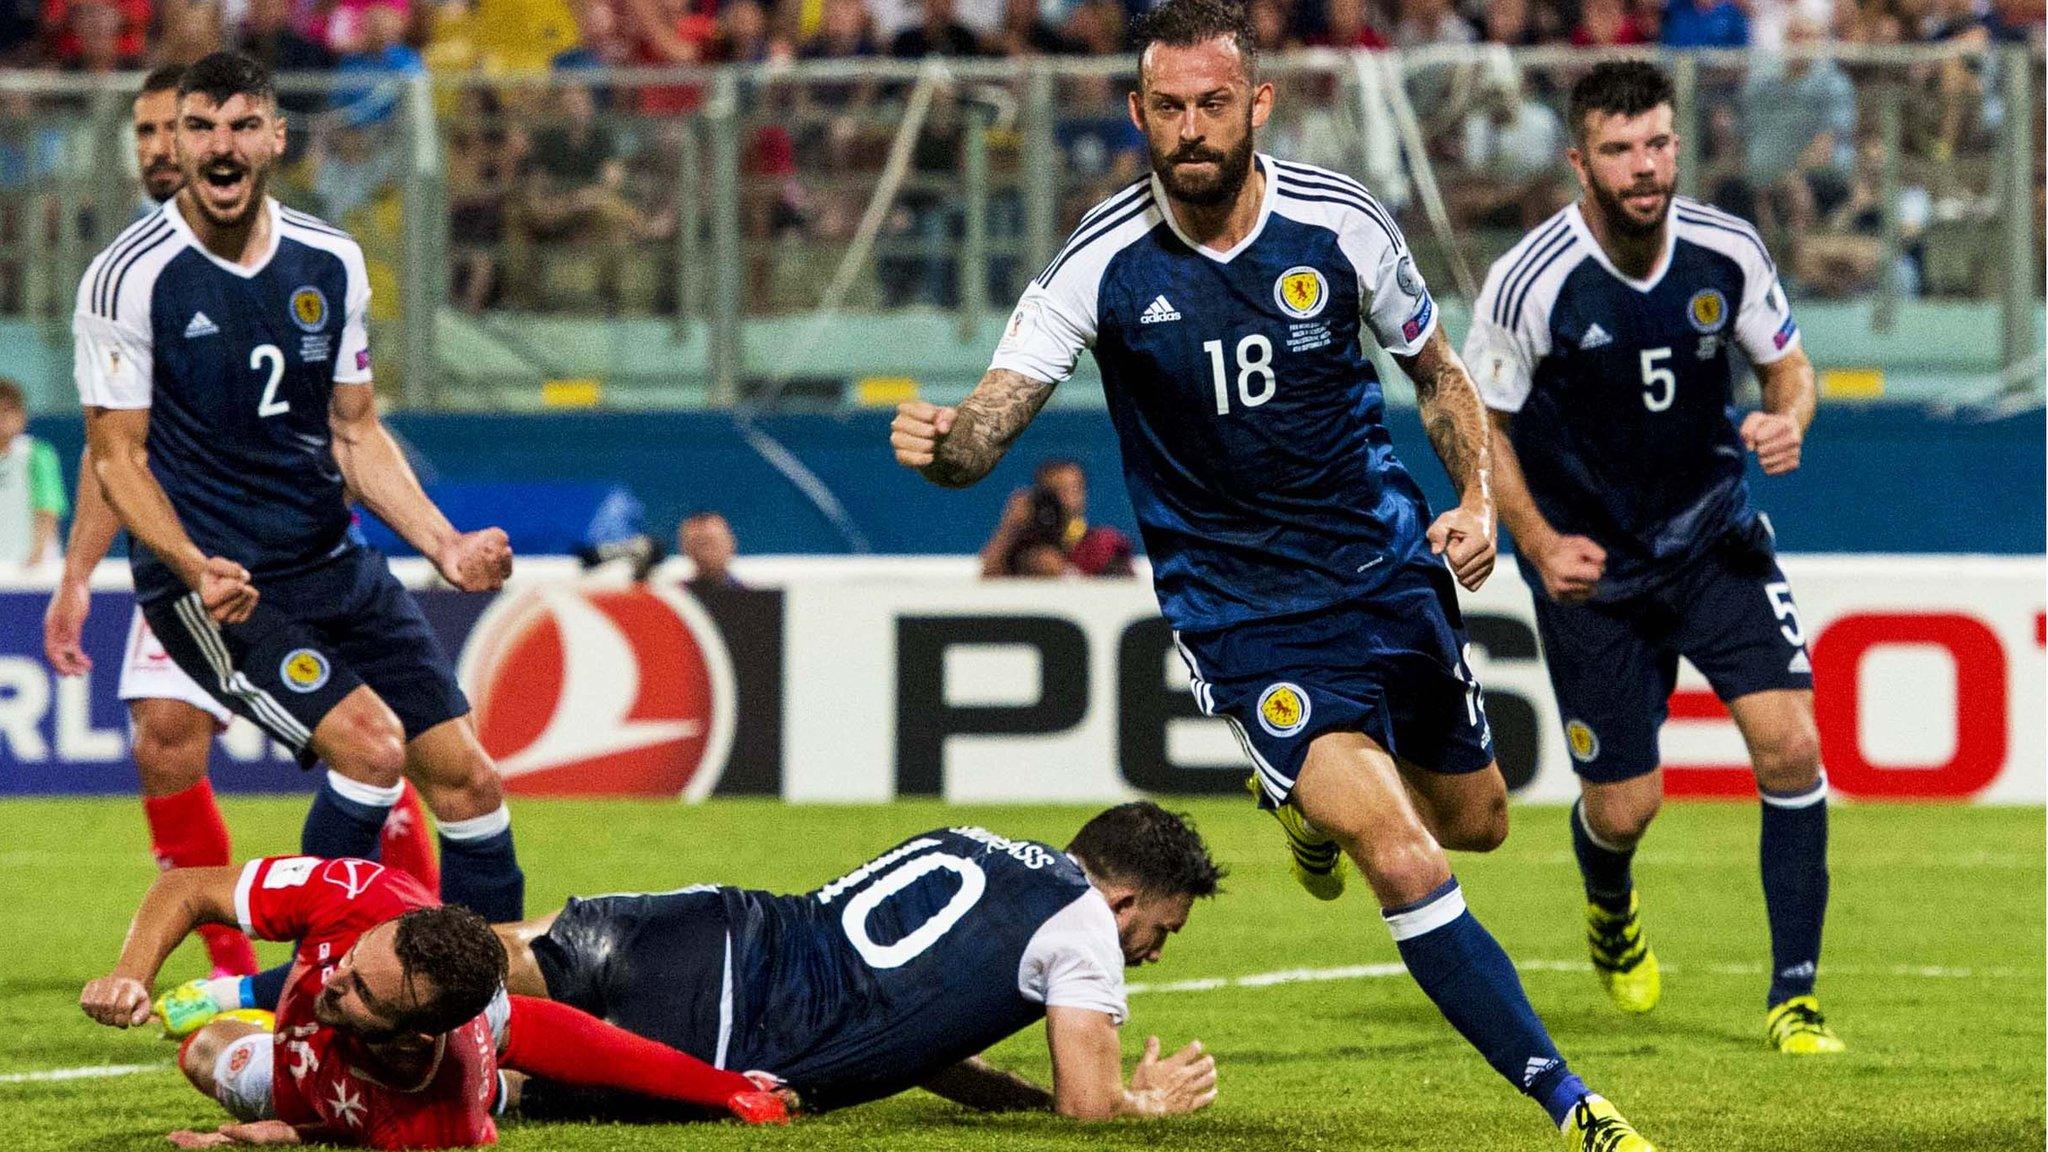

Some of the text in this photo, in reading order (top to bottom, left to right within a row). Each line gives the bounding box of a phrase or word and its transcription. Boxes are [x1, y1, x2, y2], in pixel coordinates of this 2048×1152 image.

[1140, 311, 1182, 324] adidas
[250, 344, 290, 417] 2
[1203, 334, 1276, 416] 18
[1640, 347, 1676, 412] 5
[1764, 581, 1806, 646] 5
[817, 837, 986, 969] 10
